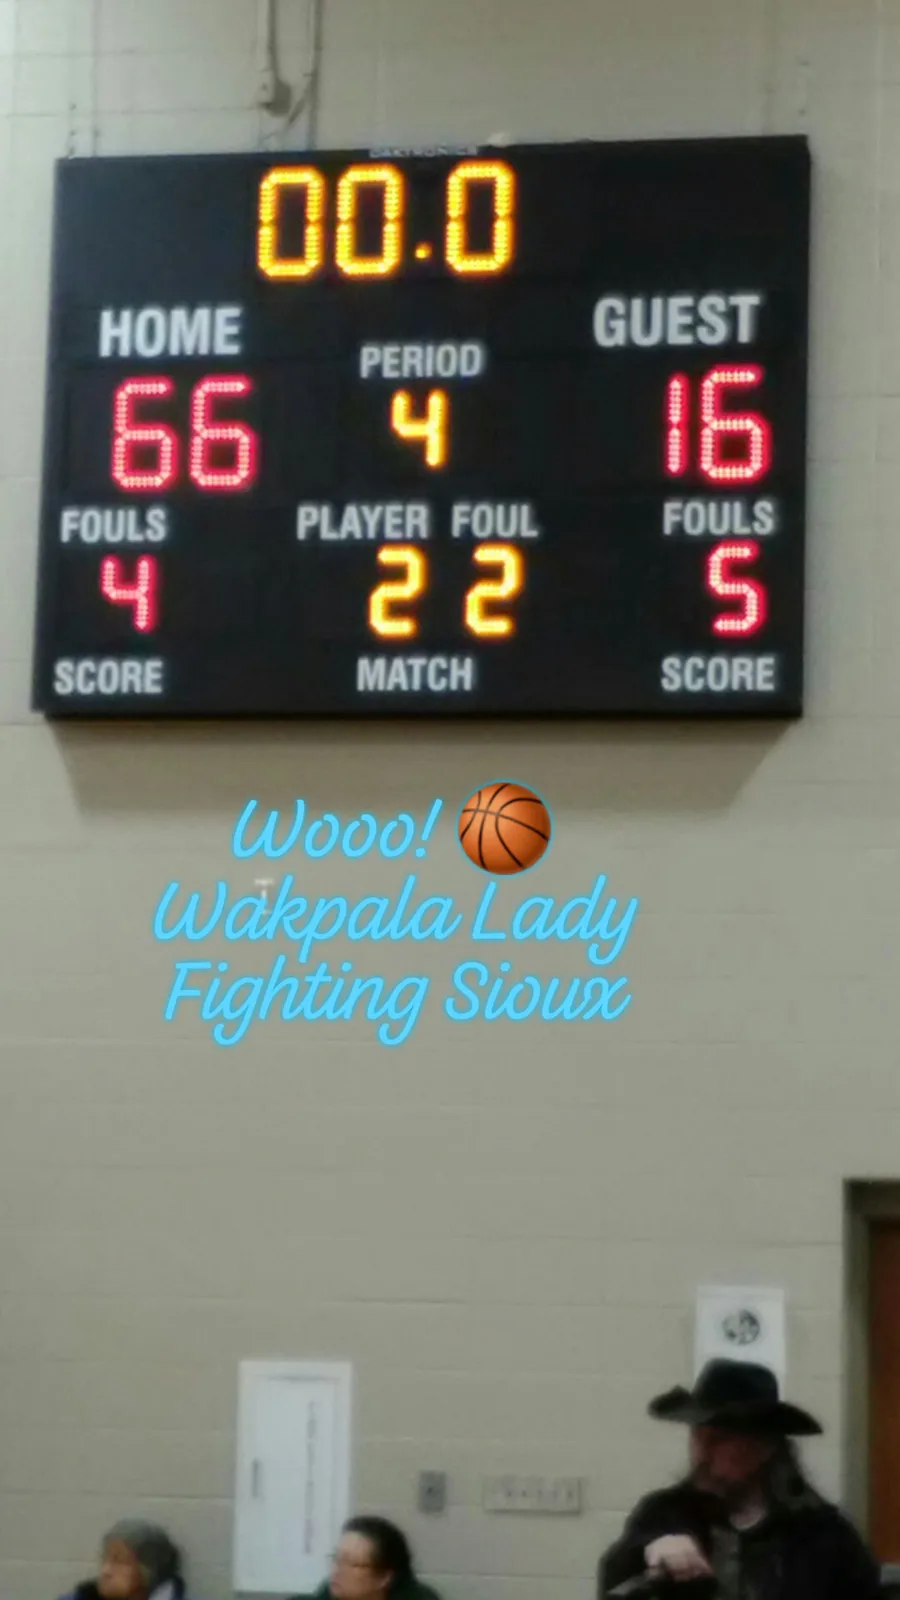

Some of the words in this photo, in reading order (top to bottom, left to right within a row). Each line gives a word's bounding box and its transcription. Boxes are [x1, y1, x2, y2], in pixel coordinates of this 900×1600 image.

[257, 163, 515, 277] 00.0
[99, 306, 242, 358] HOME
[593, 295, 760, 347] GUEST
[360, 344, 483, 379] PERIOD
[112, 376, 255, 490] 66
[391, 390, 447, 468] 4
[666, 365, 769, 482] 16
[60, 507, 167, 543] FOULS
[297, 504, 429, 540] PLAYER
[451, 503, 538, 538] FOUL
[663, 500, 775, 535] FOULS
[101, 556, 155, 631] 4
[369, 545, 425, 637] 2
[465, 544, 522, 636] 2
[708, 541, 764, 634] 5
[54, 659, 163, 694] SCORE
[357, 656, 474, 691] MATCH
[661, 656, 775, 692] SCORE
